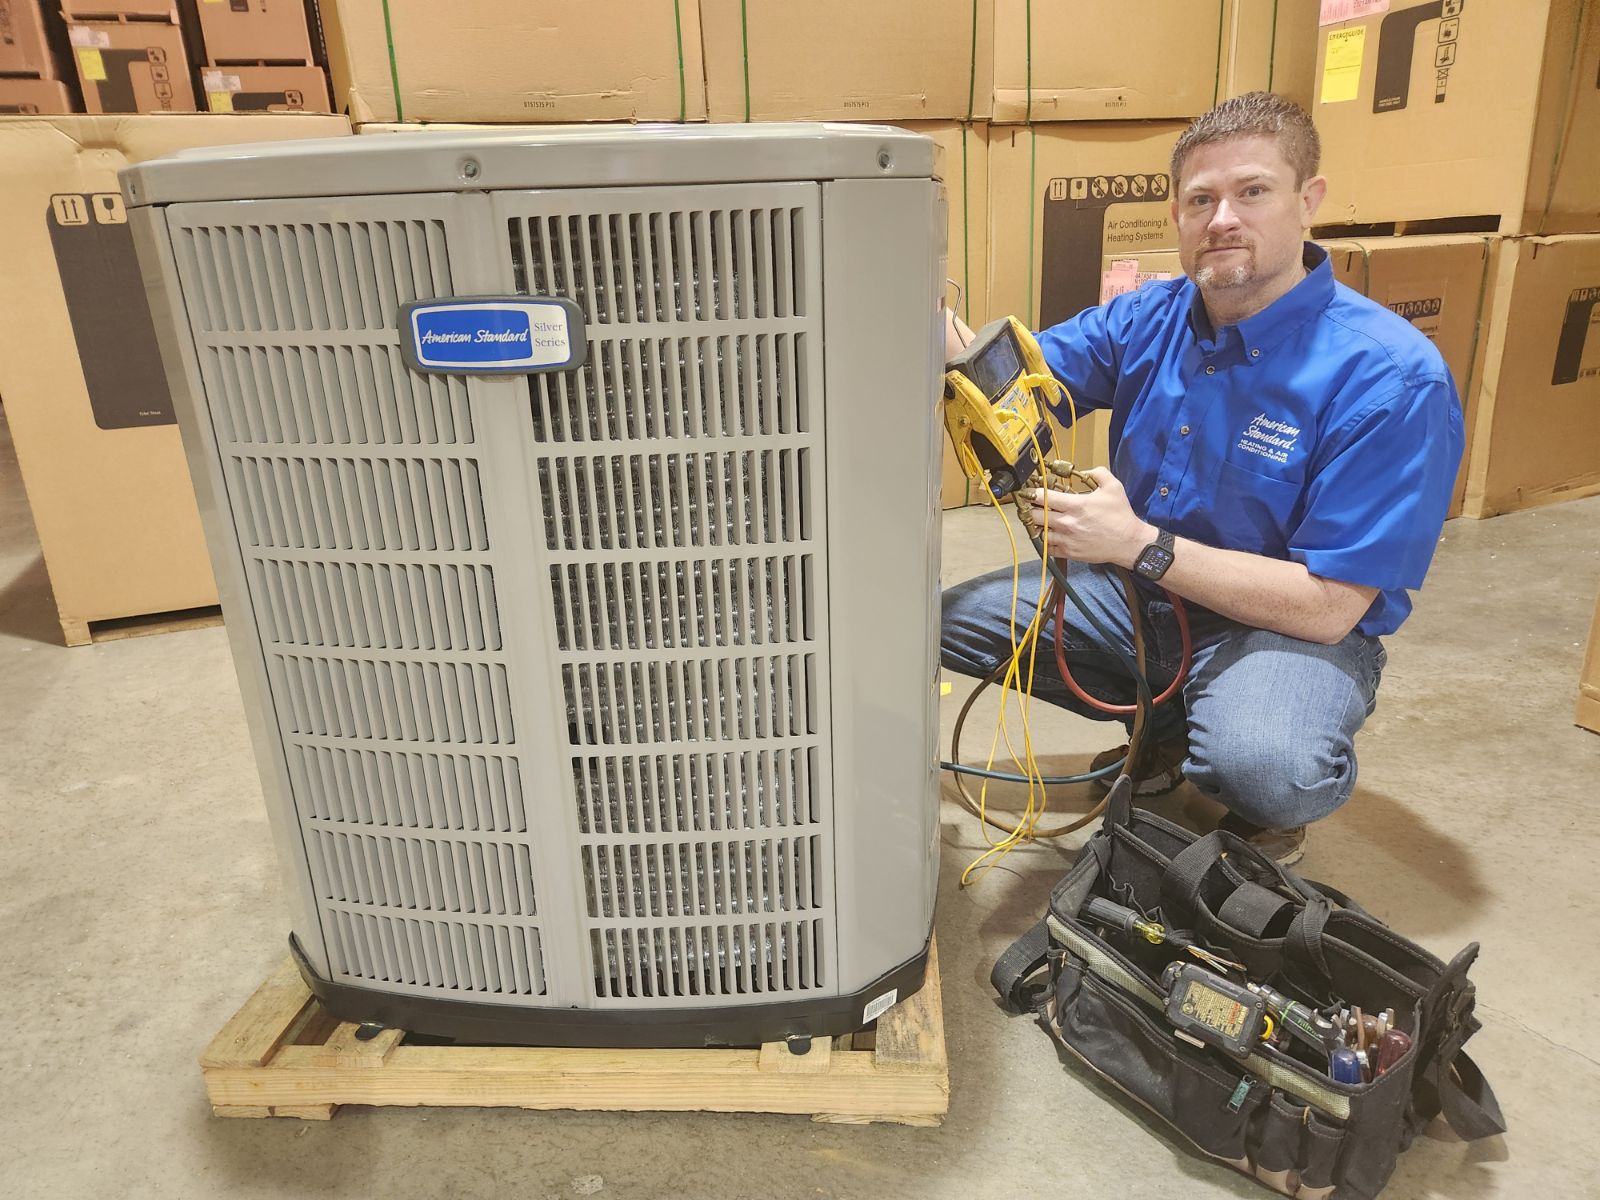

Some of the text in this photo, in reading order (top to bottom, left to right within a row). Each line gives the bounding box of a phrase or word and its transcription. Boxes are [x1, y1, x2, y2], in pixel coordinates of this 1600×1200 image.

[1107, 217, 1168, 230] Air Conditioning &
[1107, 231, 1164, 243] Heating Systems
[534, 322, 563, 332] Silver
[422, 328, 529, 345] American Standard
[535, 337, 566, 347] Series
[1250, 412, 1300, 437] American
[1243, 425, 1297, 449] Standard
[1237, 443, 1288, 463] CONDITIONING
[1240, 439, 1289, 459] HEATING & AIR
